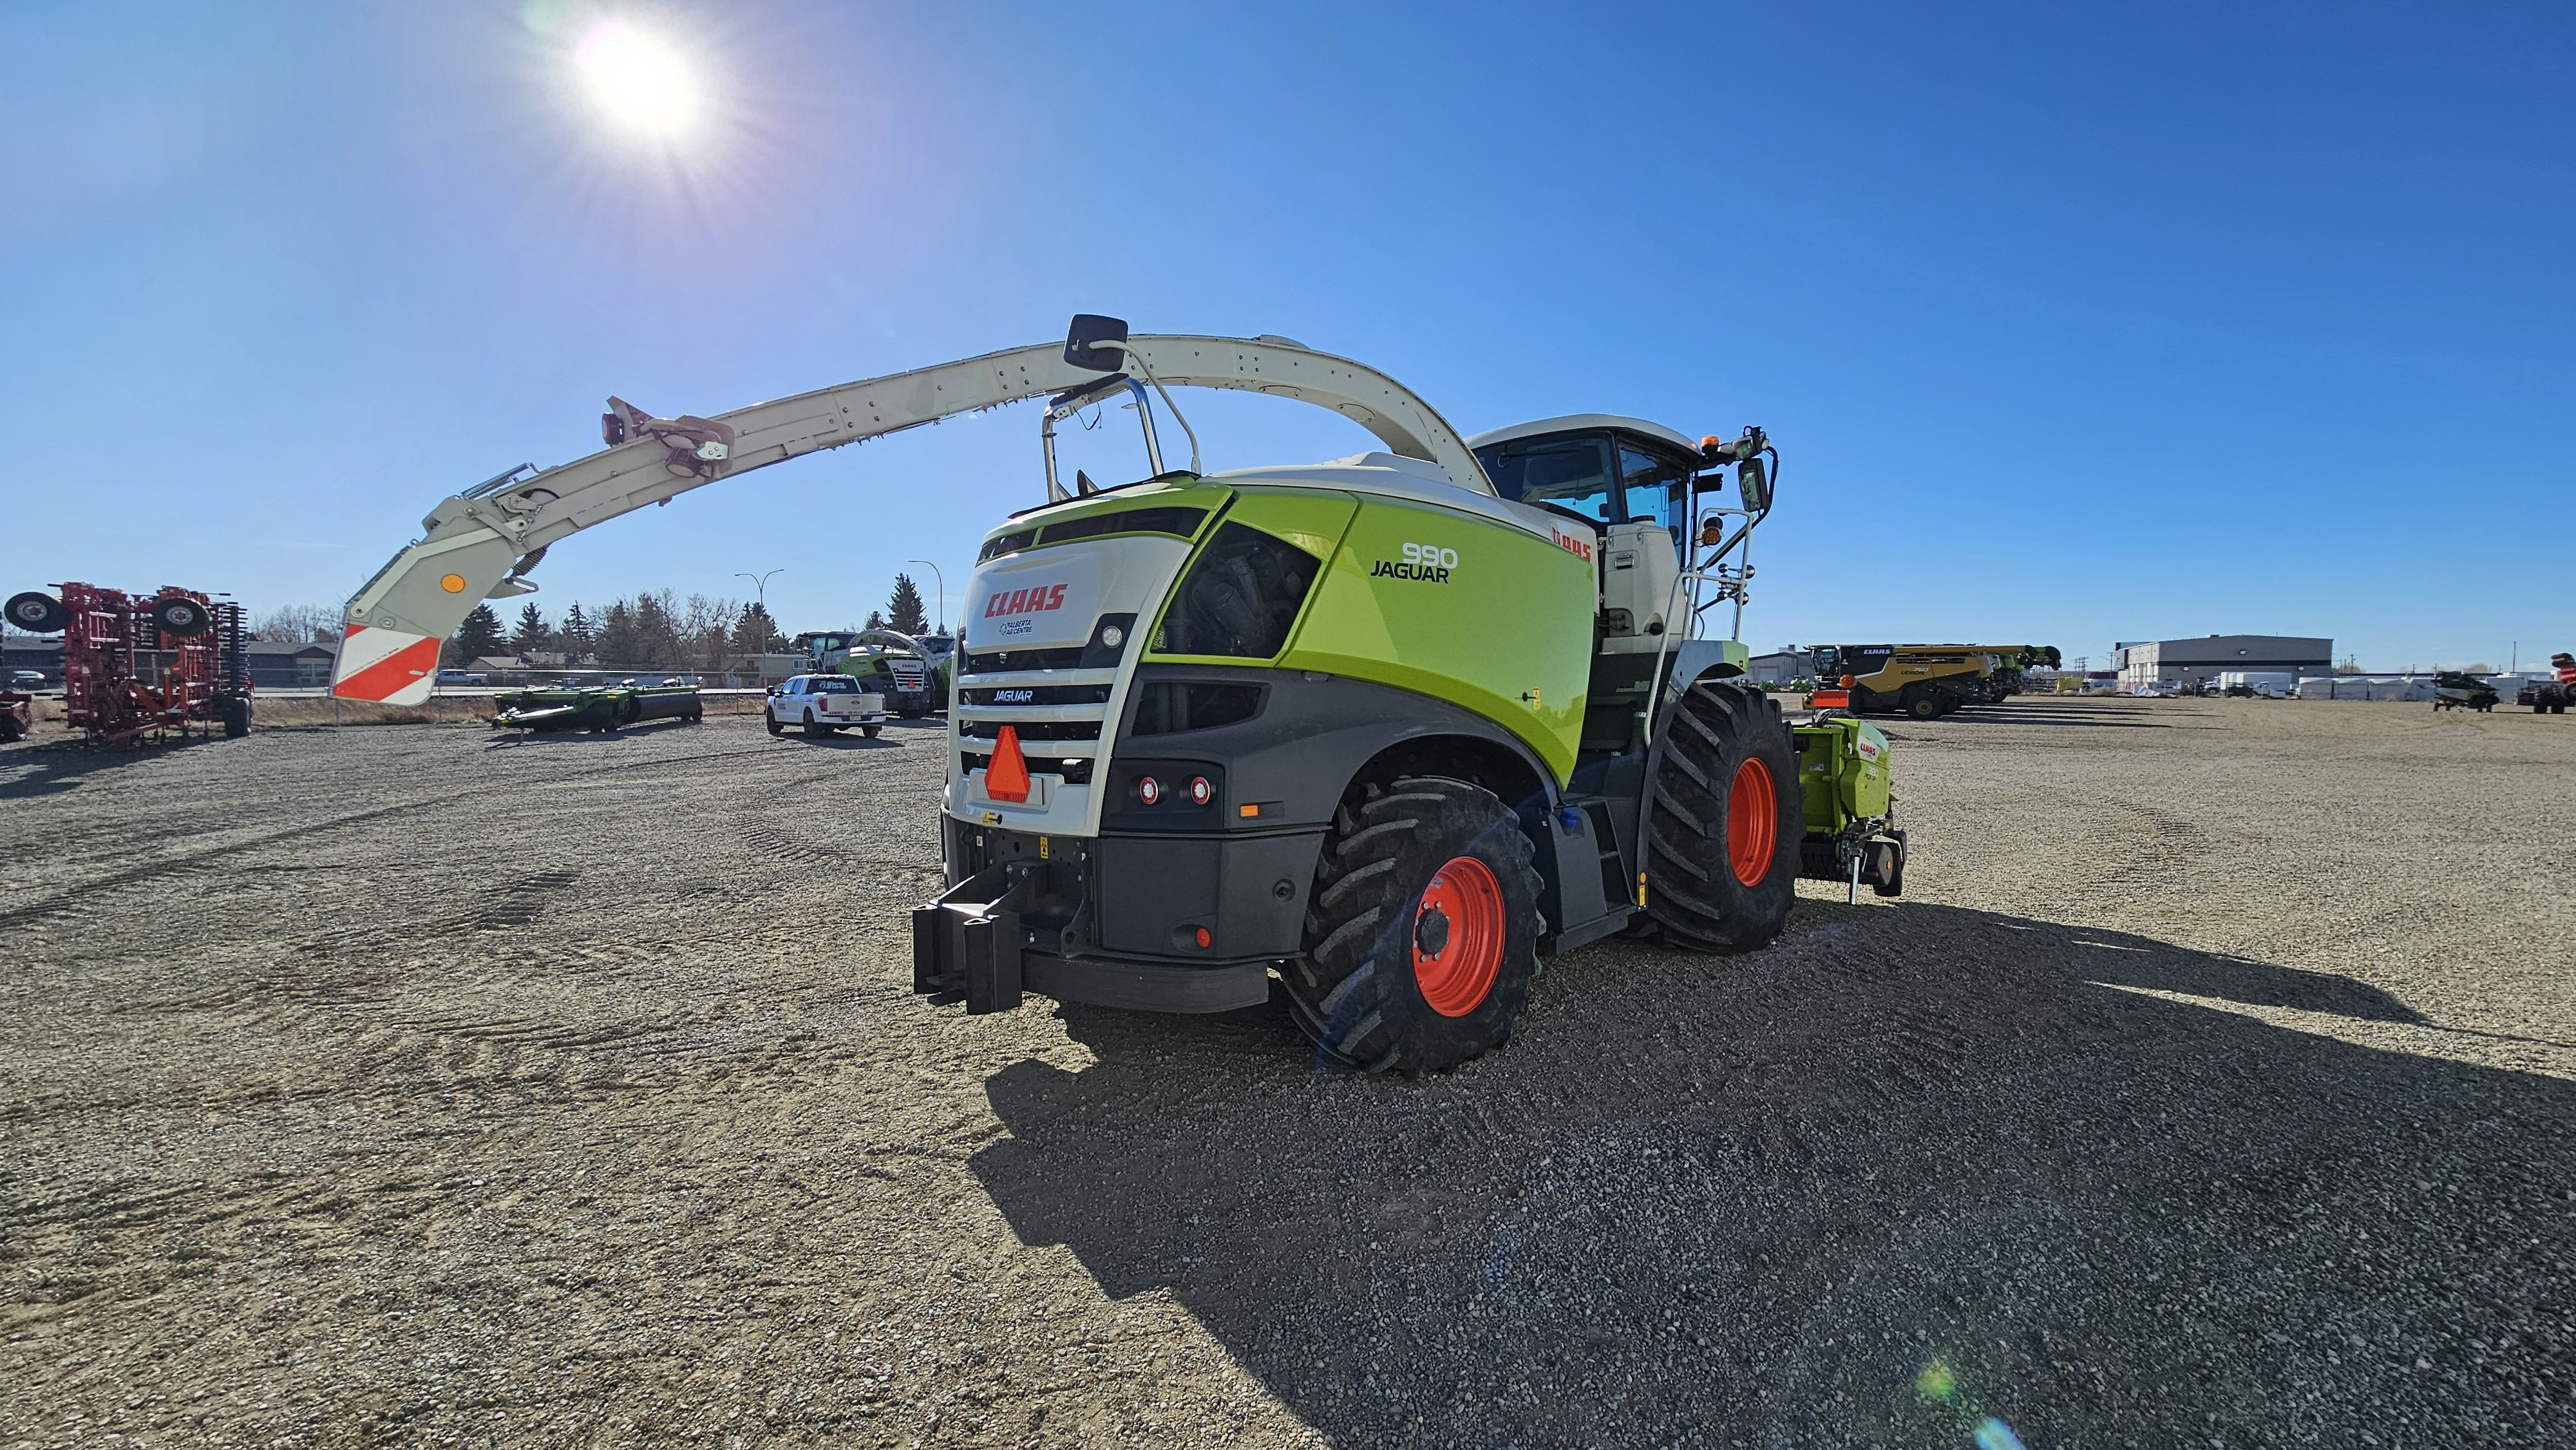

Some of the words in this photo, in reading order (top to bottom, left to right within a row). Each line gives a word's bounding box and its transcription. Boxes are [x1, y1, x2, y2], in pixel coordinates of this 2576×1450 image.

[1402, 542, 1458, 569] 990
[1370, 560, 1449, 584] JAGUAR
[985, 583, 1068, 618] CLAAS
[1009, 619, 1032, 628] ALBERTA
[1014, 626, 1033, 634] CENTRE
[994, 690, 1033, 702] JAGUAR
[1861, 743, 1876, 756] CLAAS
